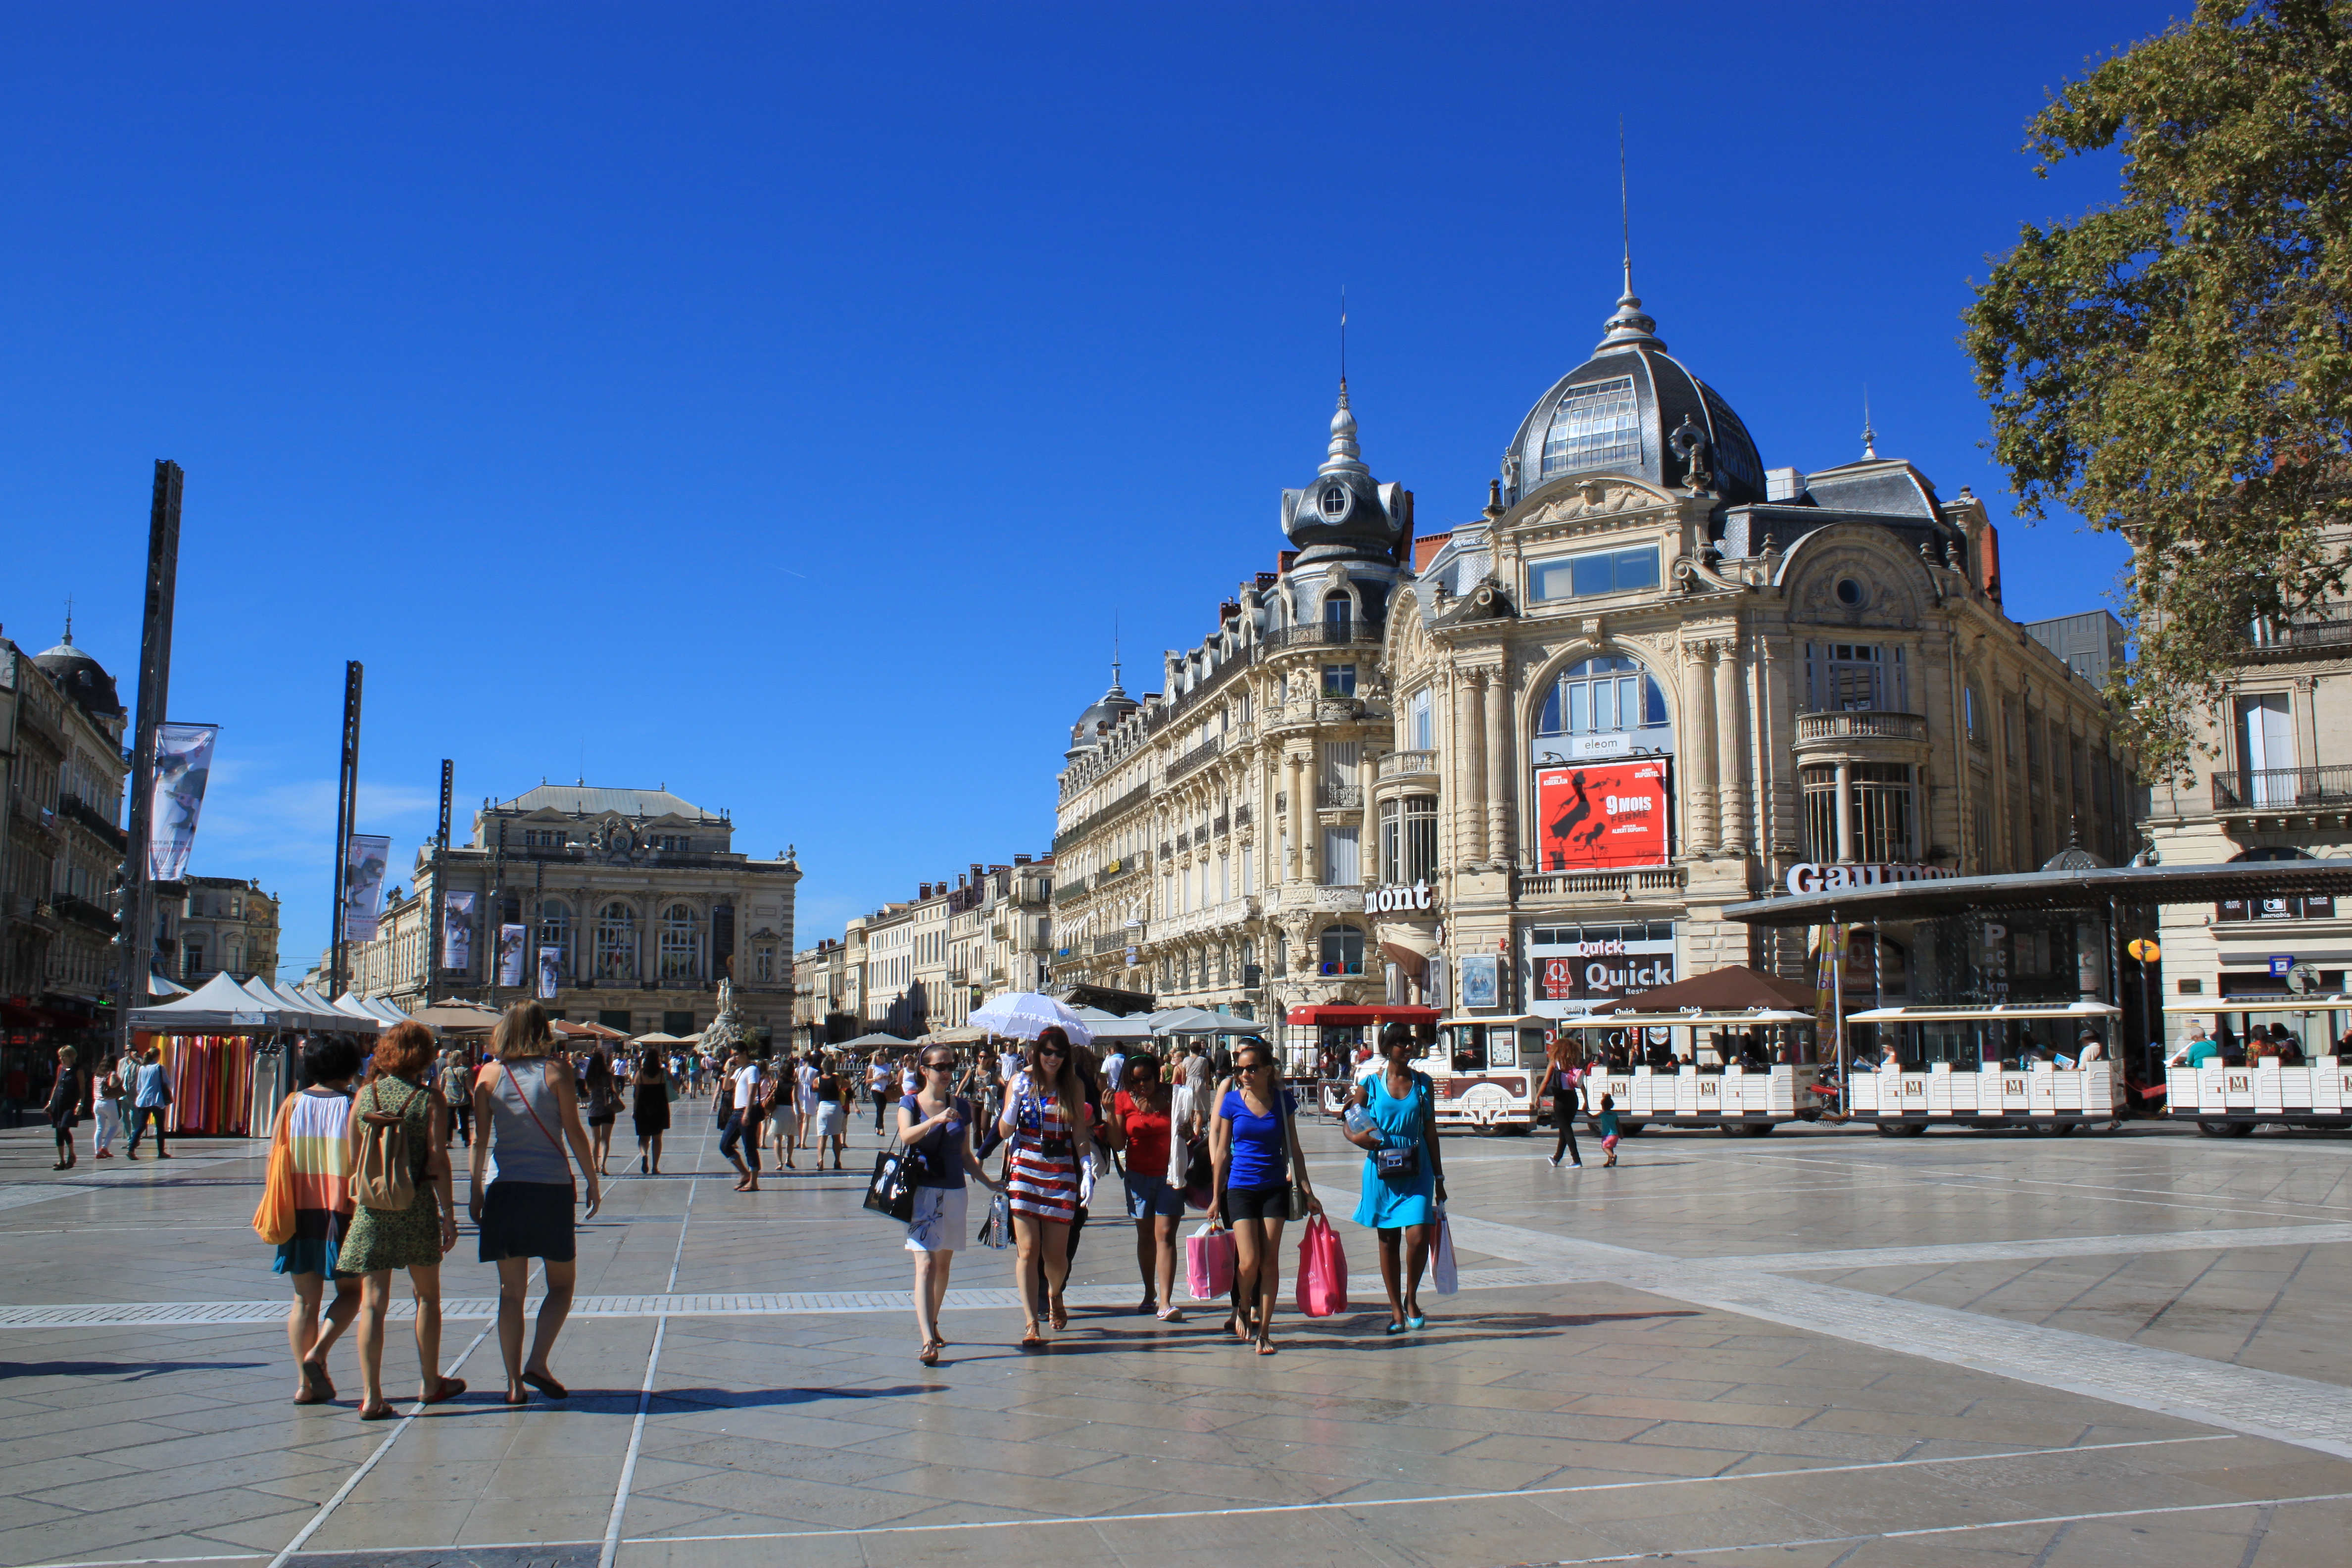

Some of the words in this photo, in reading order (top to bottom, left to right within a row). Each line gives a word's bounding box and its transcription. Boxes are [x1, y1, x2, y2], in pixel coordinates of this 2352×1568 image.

[1585, 739, 1617, 749] eleom
[1606, 795, 1617, 815] 9
[1618, 796, 1652, 813] MOIS
[1578, 939, 1624, 957] Quick
[1323, 962, 1359, 975] CIC
[1549, 962, 1567, 982] Q
[1585, 960, 1672, 991] Quick
[1908, 1081, 1919, 1091] M
[2009, 1080, 2019, 1090] M
[2232, 1077, 2245, 1087] M
[1614, 1083, 1623, 1092] M
[1703, 1083, 1713, 1092] M
